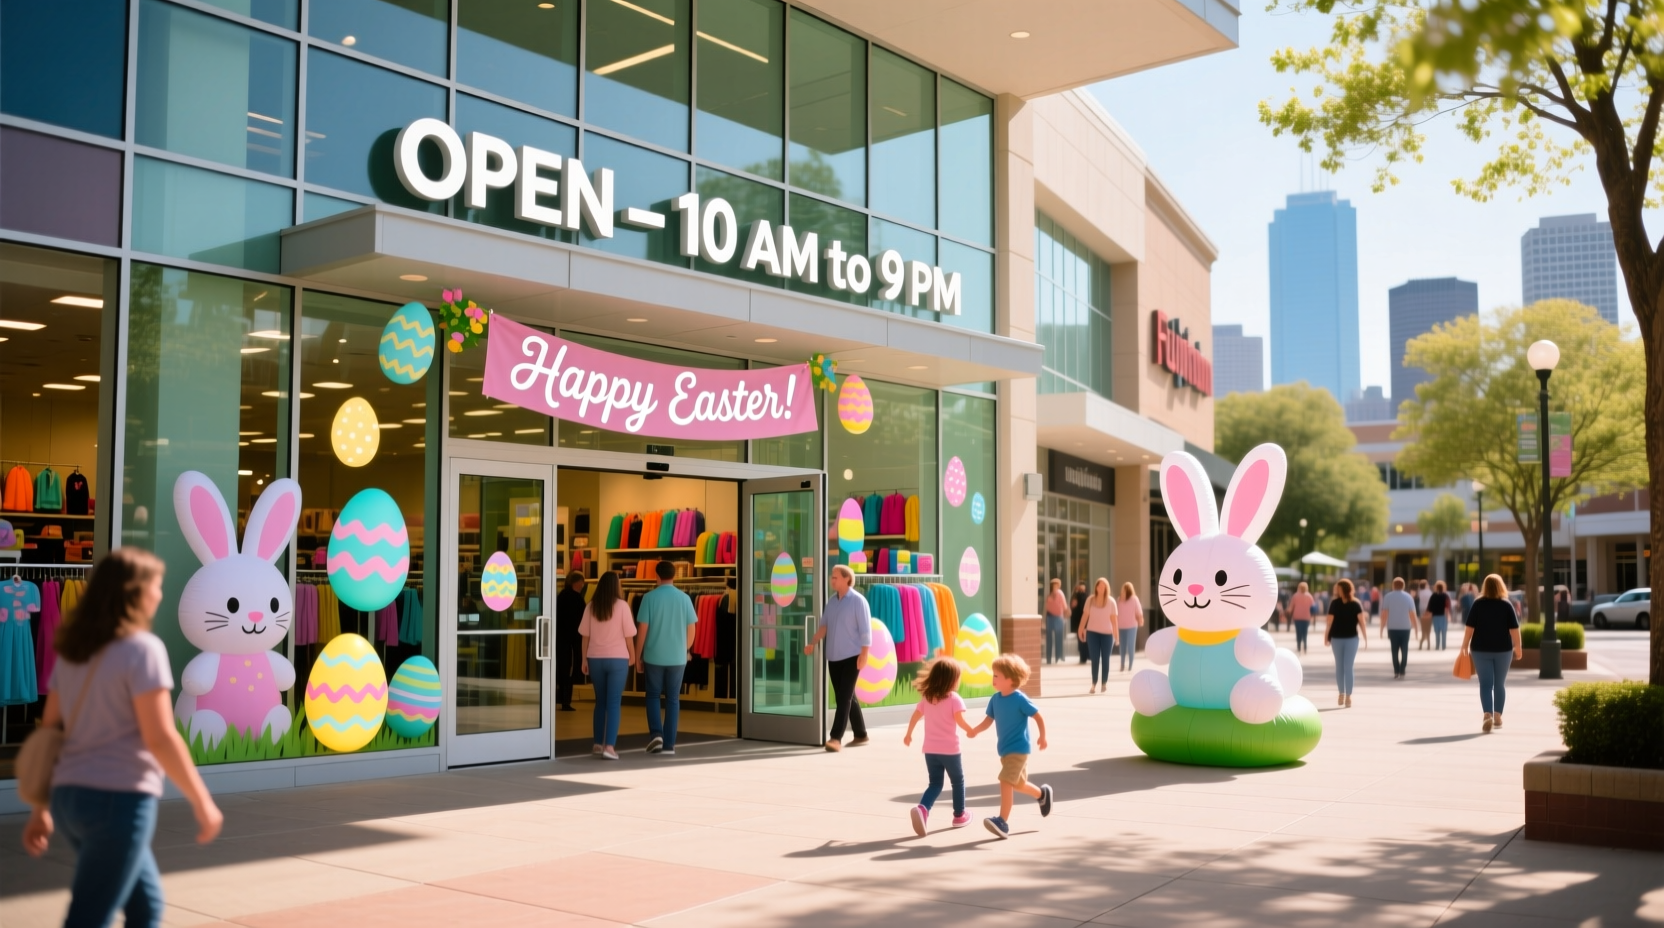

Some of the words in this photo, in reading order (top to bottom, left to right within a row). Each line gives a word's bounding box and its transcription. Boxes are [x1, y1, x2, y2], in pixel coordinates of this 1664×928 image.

[394, 118, 614, 239] OPEN
[671, 192, 738, 264] 10
[741, 218, 819, 283] AM
[825, 239, 871, 294] to
[877, 249, 904, 301] 9
[907, 260, 961, 315] PM
[510, 335, 658, 433] Happy
[668, 371, 796, 426] Easter!
